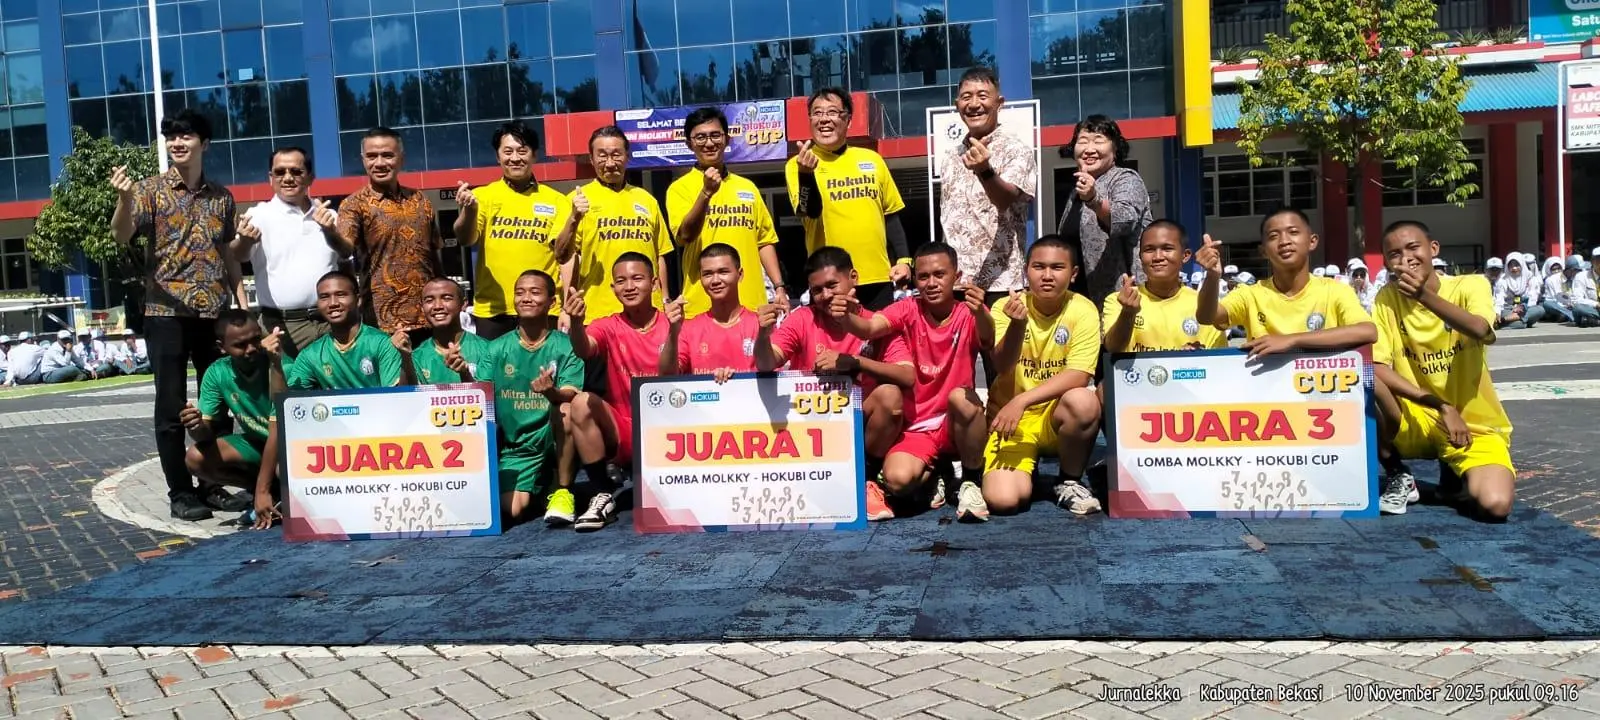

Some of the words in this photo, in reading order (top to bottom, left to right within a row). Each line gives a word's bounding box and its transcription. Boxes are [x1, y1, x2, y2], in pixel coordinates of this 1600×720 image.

[745, 130, 784, 145] CUP
[827, 174, 875, 189] Hokubi
[830, 186, 879, 200] Molkky
[707, 204, 752, 215] Hokubi
[491, 215, 548, 229] Hokubi
[597, 216, 649, 229] Hokubi
[707, 216, 755, 230] Molkky
[490, 228, 549, 243] Molkky
[598, 228, 652, 242] Molkky
[1294, 358, 1357, 369] HOKUBI
[1173, 370, 1205, 379] HOKUBI
[795, 382, 848, 393] HOKUBI
[1293, 371, 1360, 394] CUP
[430, 395, 480, 406] HOKUBI
[514, 400, 550, 411] Molkky
[794, 391, 850, 415] CUP
[332, 407, 359, 416] HOKUBI
[430, 406, 483, 428] CUP
[1140, 409, 1297, 443] JUARA
[1307, 408, 1336, 440] 3
[665, 428, 801, 462] JUARA
[806, 428, 824, 457] 1
[306, 441, 433, 474] JUARA
[441, 439, 465, 468] 2
[1137, 455, 1183, 467] LOMBA
[1187, 455, 1243, 467] MOLKKY
[1256, 454, 1308, 466] HOKUBI
[1311, 454, 1339, 466] CUP
[659, 474, 699, 485] LOMBA
[701, 473, 750, 484] MOLKKY
[761, 471, 806, 482] HOKUBI
[809, 470, 833, 481] CUP
[305, 483, 343, 496] LOMBA
[345, 483, 390, 495] MOLKKY
[401, 482, 443, 492] HOKUBI
[446, 480, 468, 491] CUP
